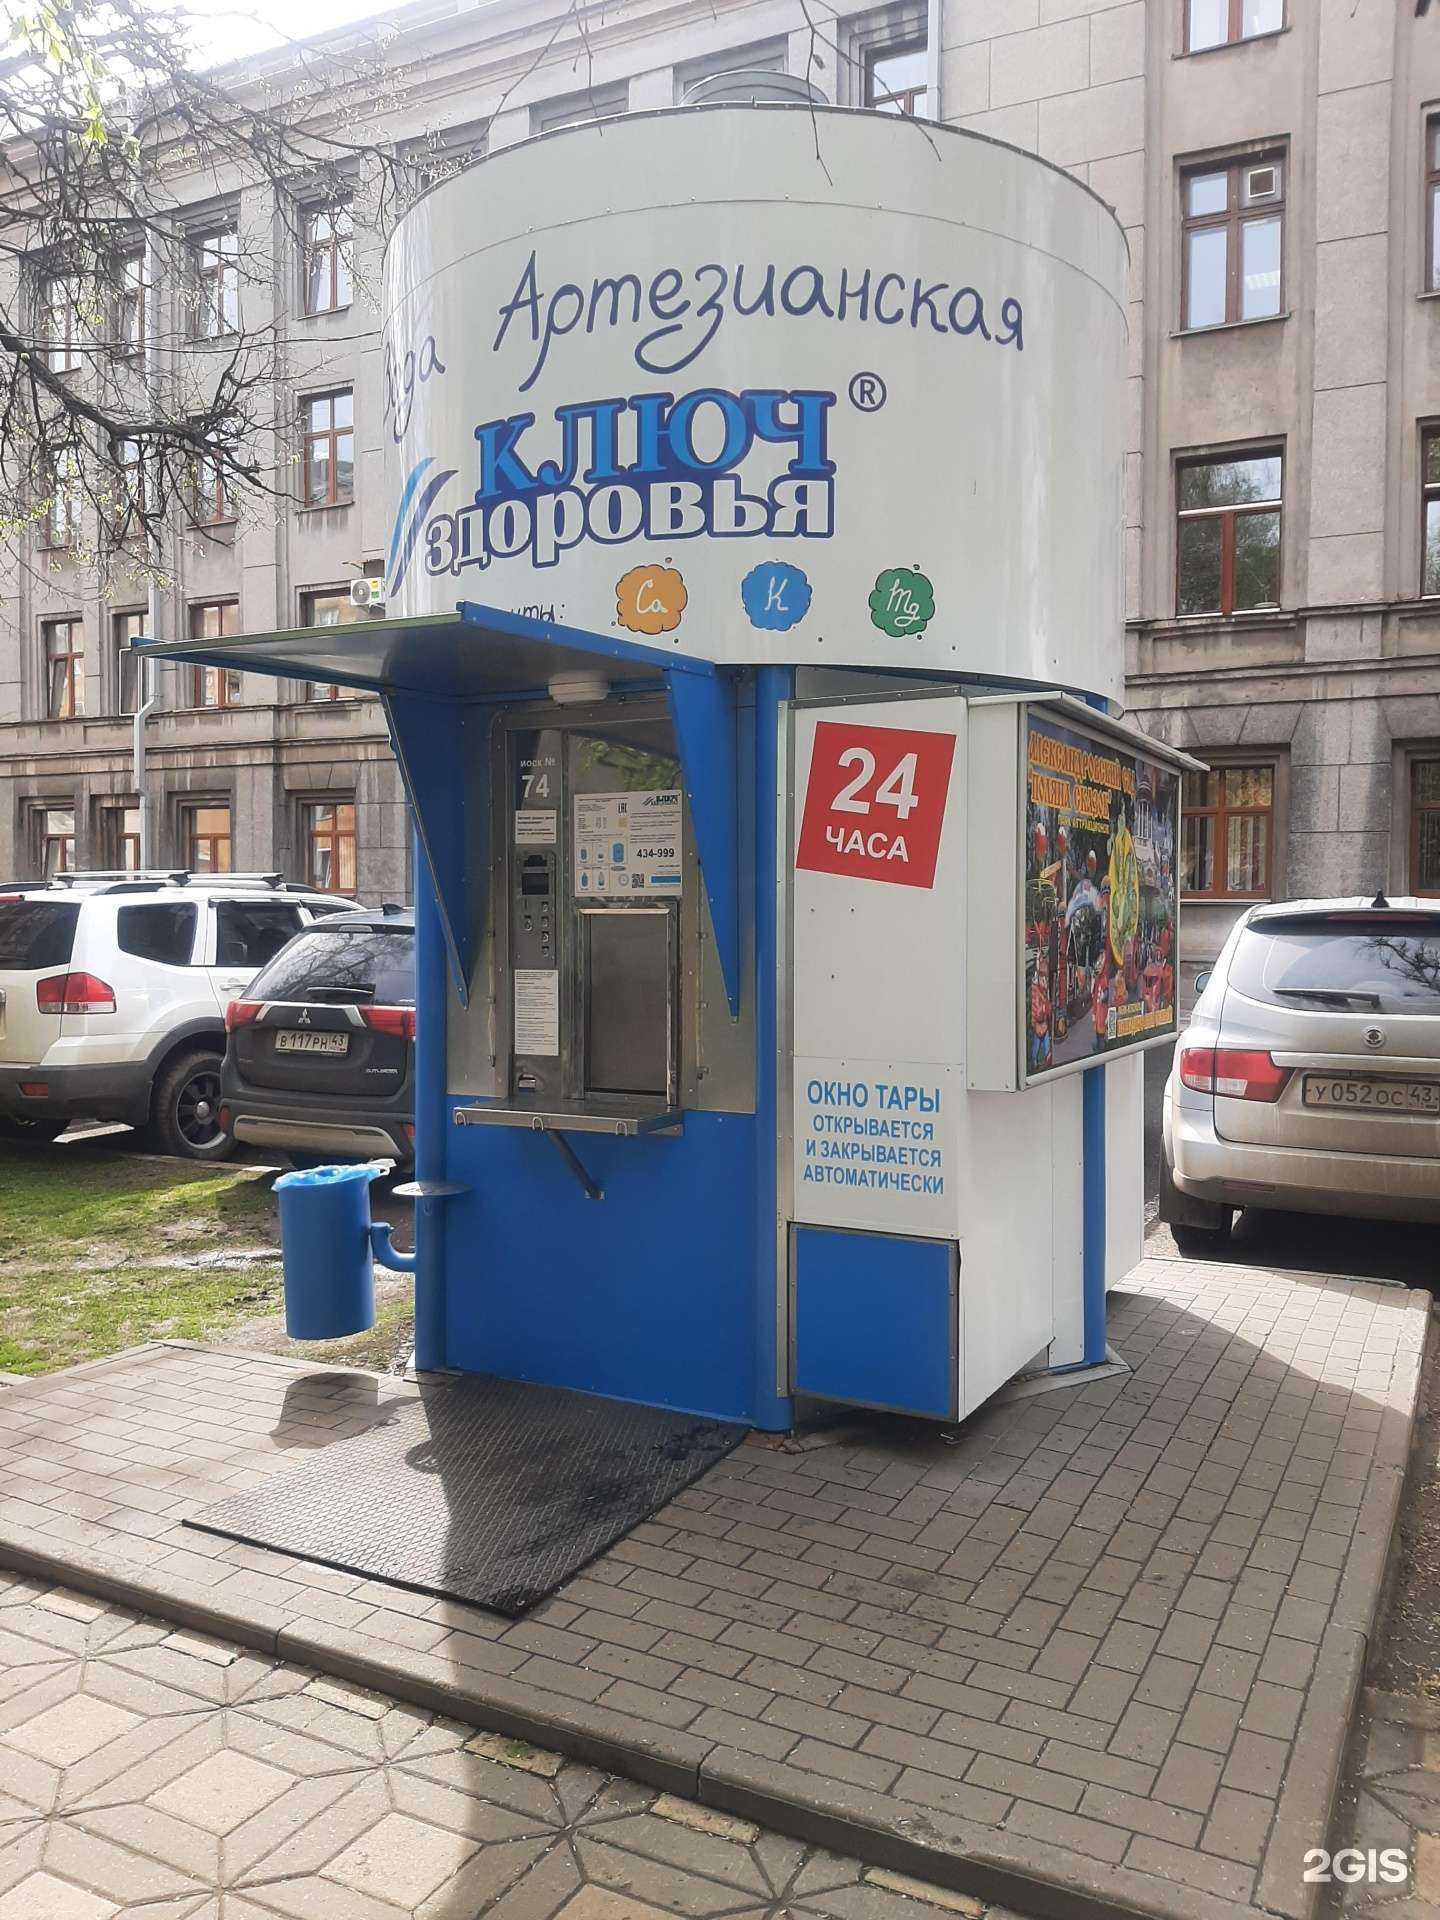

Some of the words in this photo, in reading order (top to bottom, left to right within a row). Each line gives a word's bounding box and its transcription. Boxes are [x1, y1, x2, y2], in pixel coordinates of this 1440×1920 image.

[493, 250, 1024, 393] Артезианская
[474, 388, 837, 502] КЛЮЧ
[424, 473, 835, 577] здоровья
[636, 579, 669, 613] Ca
[764, 576, 789, 611] K
[521, 774, 550, 798] 74
[830, 747, 919, 820] 24
[637, 848, 675, 858] 434-999
[826, 825, 909, 862] ЧАСА
[807, 1080, 868, 1108] ОКНО
[875, 1085, 940, 1113] ТАРЫ
[813, 1114, 934, 1141] ОТКРЫВАЕТСЯ
[806, 1139, 816, 1157] И
[820, 1140, 942, 1168] ЗАКРЫВАЕТСЯ
[803, 1164, 944, 1195] АВТОМАТИЧЕСКИ
